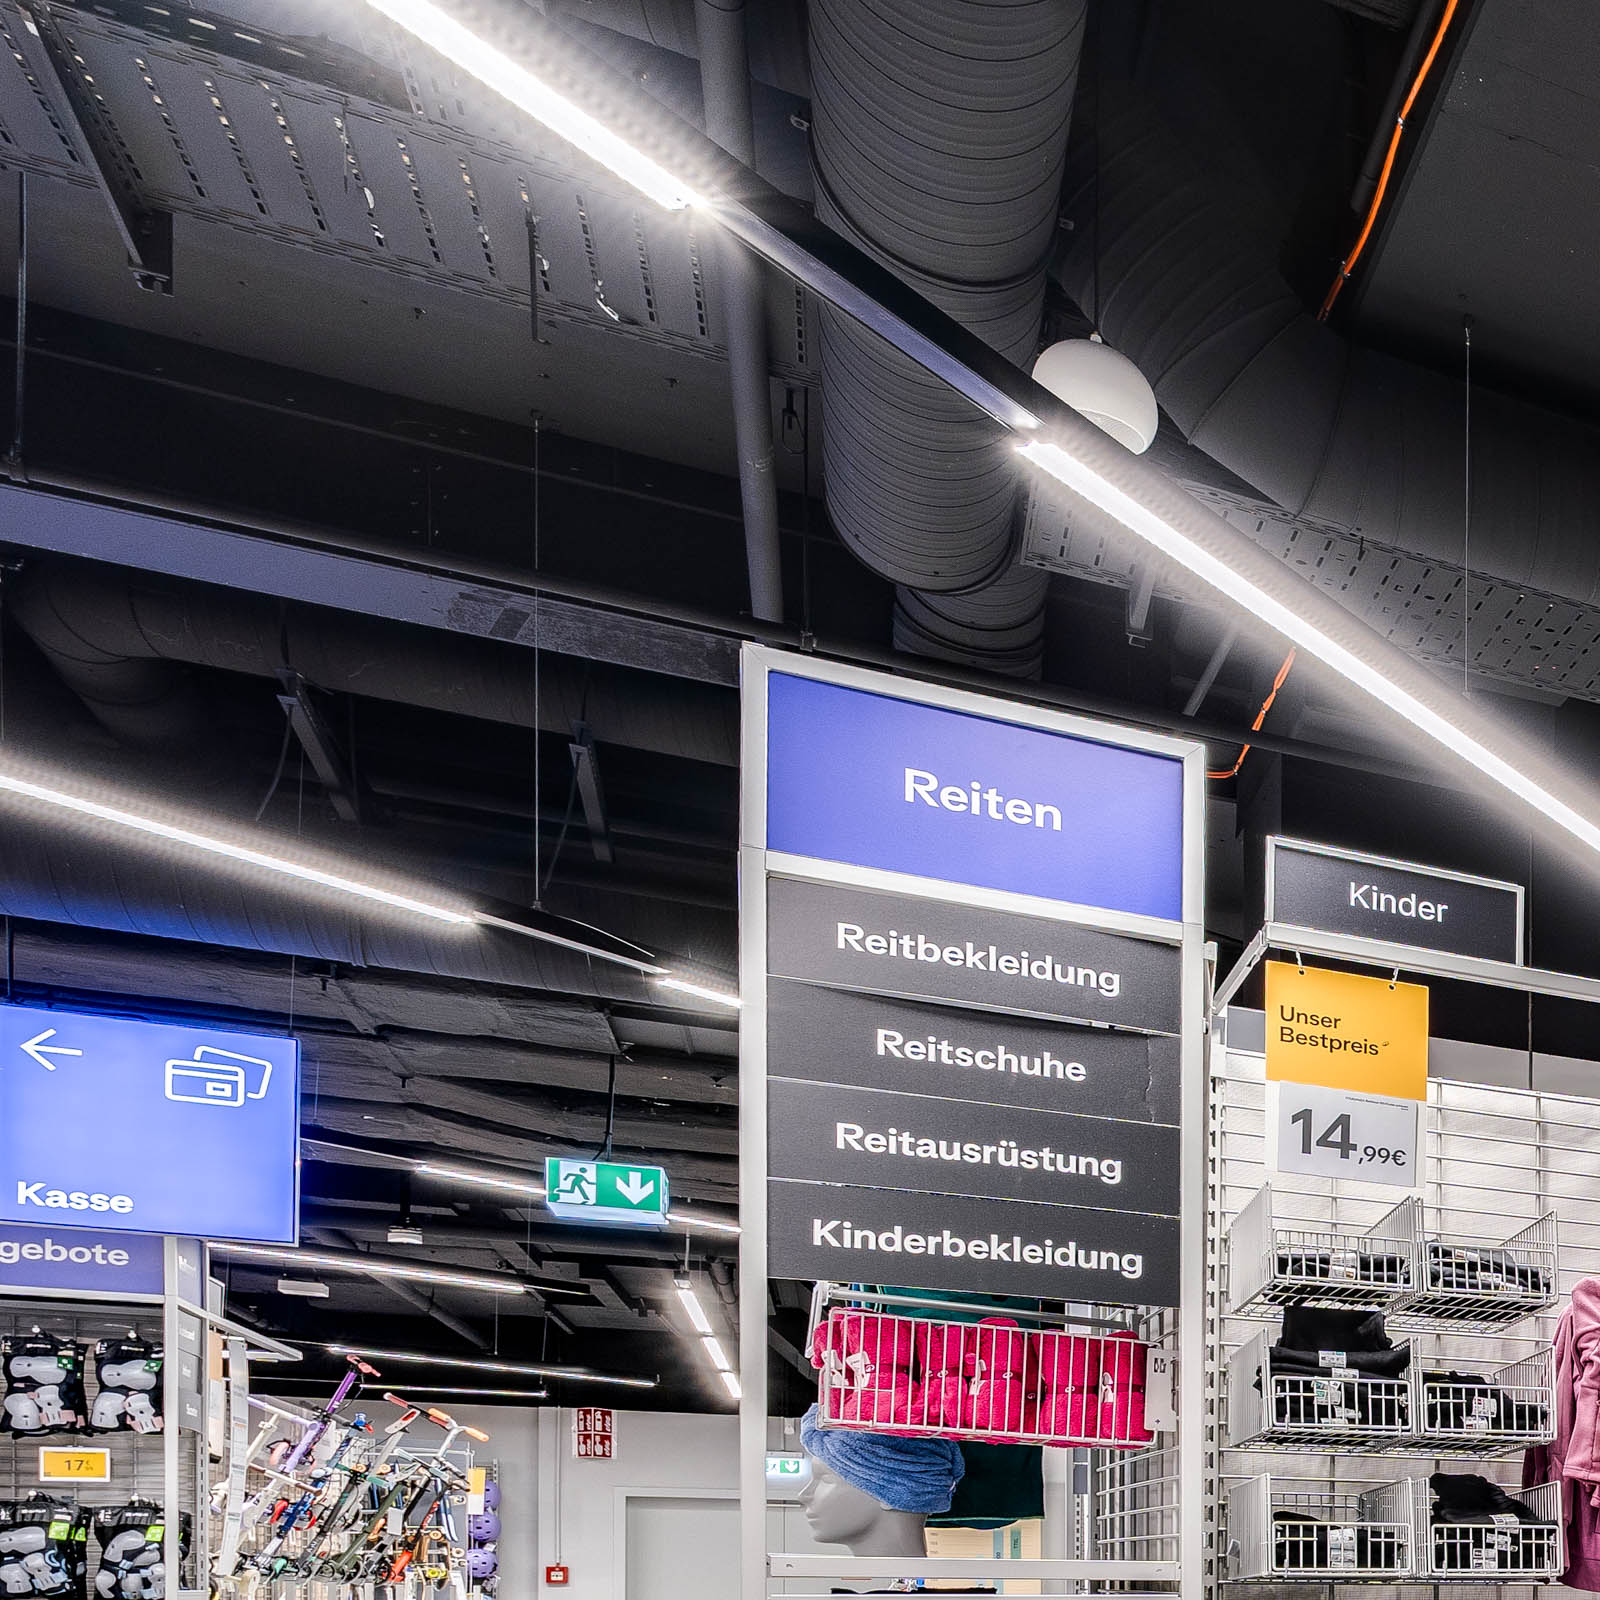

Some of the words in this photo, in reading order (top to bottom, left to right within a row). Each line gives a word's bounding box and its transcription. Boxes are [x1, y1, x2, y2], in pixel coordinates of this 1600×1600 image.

[903, 766, 1062, 832] Reiten
[1348, 882, 1449, 924] Kinder
[835, 921, 1121, 998] Reitbekleidung
[1279, 1004, 1341, 1031] Unser
[1279, 1026, 1381, 1057] Bestpreis
[875, 1027, 1088, 1083] Reitschuhe
[834, 1121, 1123, 1186] Reitausrüstung
[17, 1181, 134, 1214] Kasse
[0, 1238, 130, 1266] gebote
[811, 1218, 1144, 1279] Kinderbekleidung
